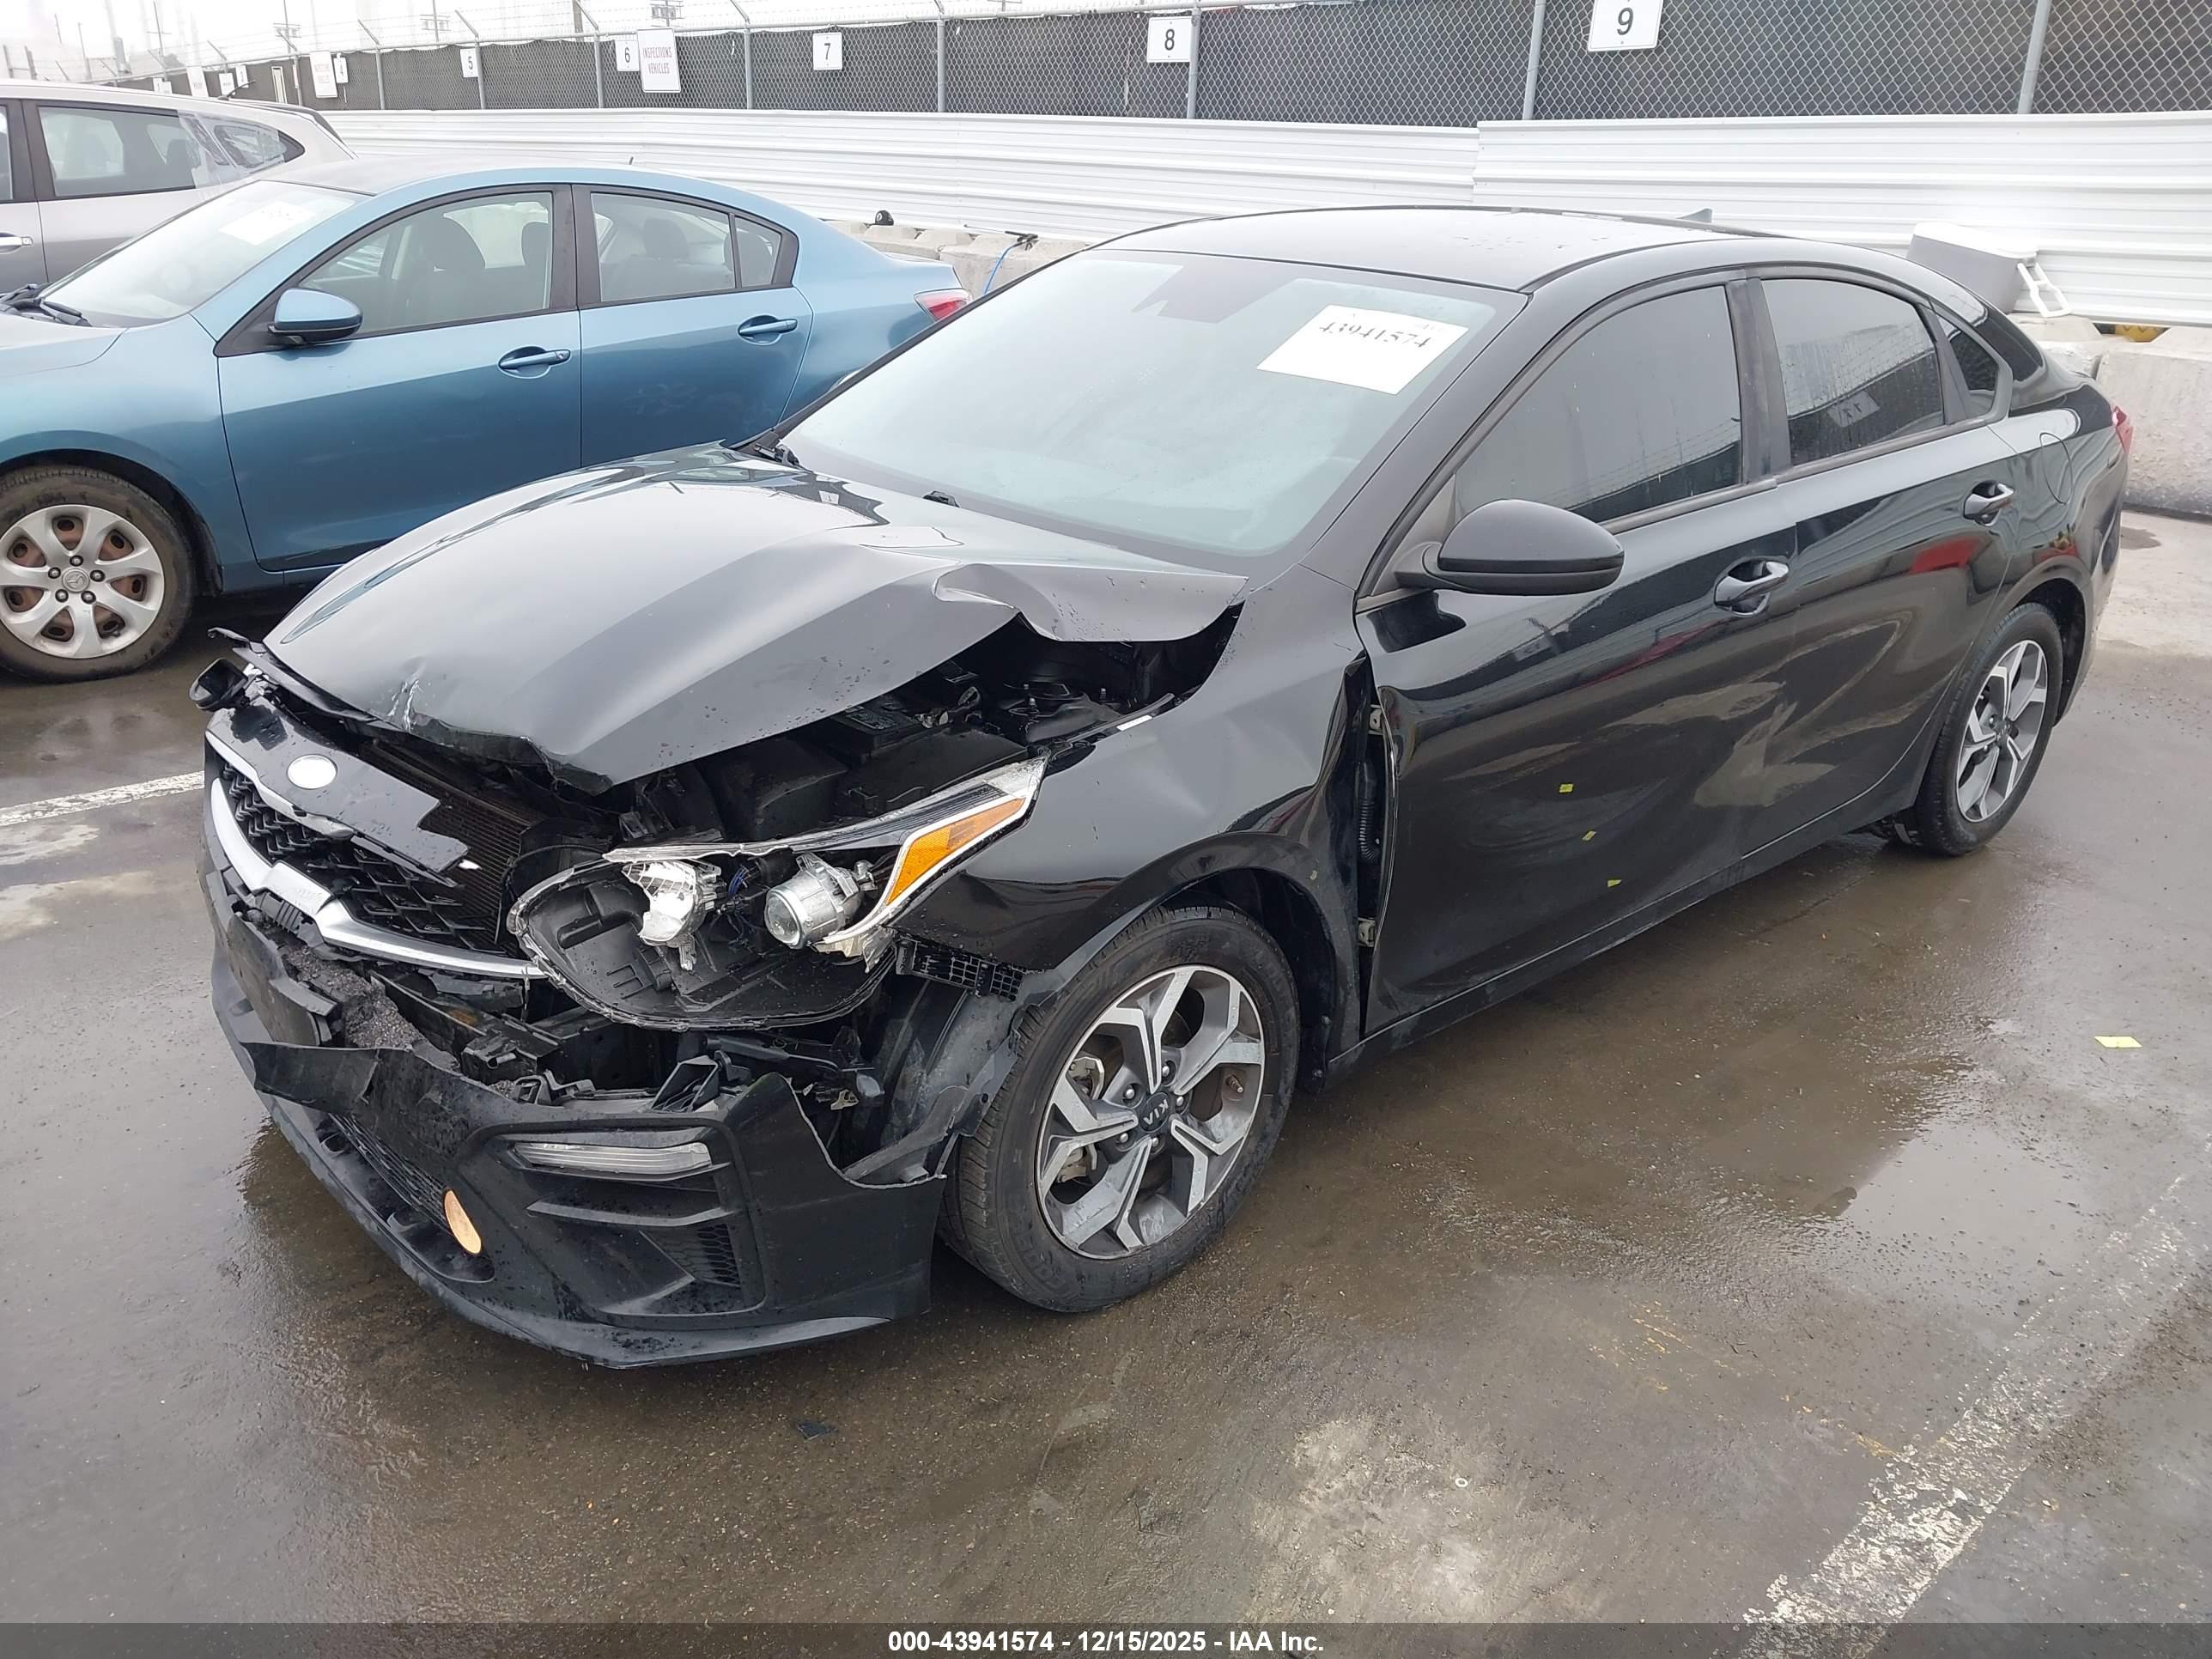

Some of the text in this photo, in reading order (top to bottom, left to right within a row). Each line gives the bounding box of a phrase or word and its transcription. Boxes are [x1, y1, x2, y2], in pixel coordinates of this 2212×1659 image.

[1617, 7, 1633, 36] 9
[1164, 28, 1175, 51] 8
[624, 46, 631, 64] 6
[642, 46, 673, 58] INSPECTIONS
[823, 42, 830, 60] 7
[467, 55, 474, 70] 5
[647, 62, 671, 75] VEHICLES
